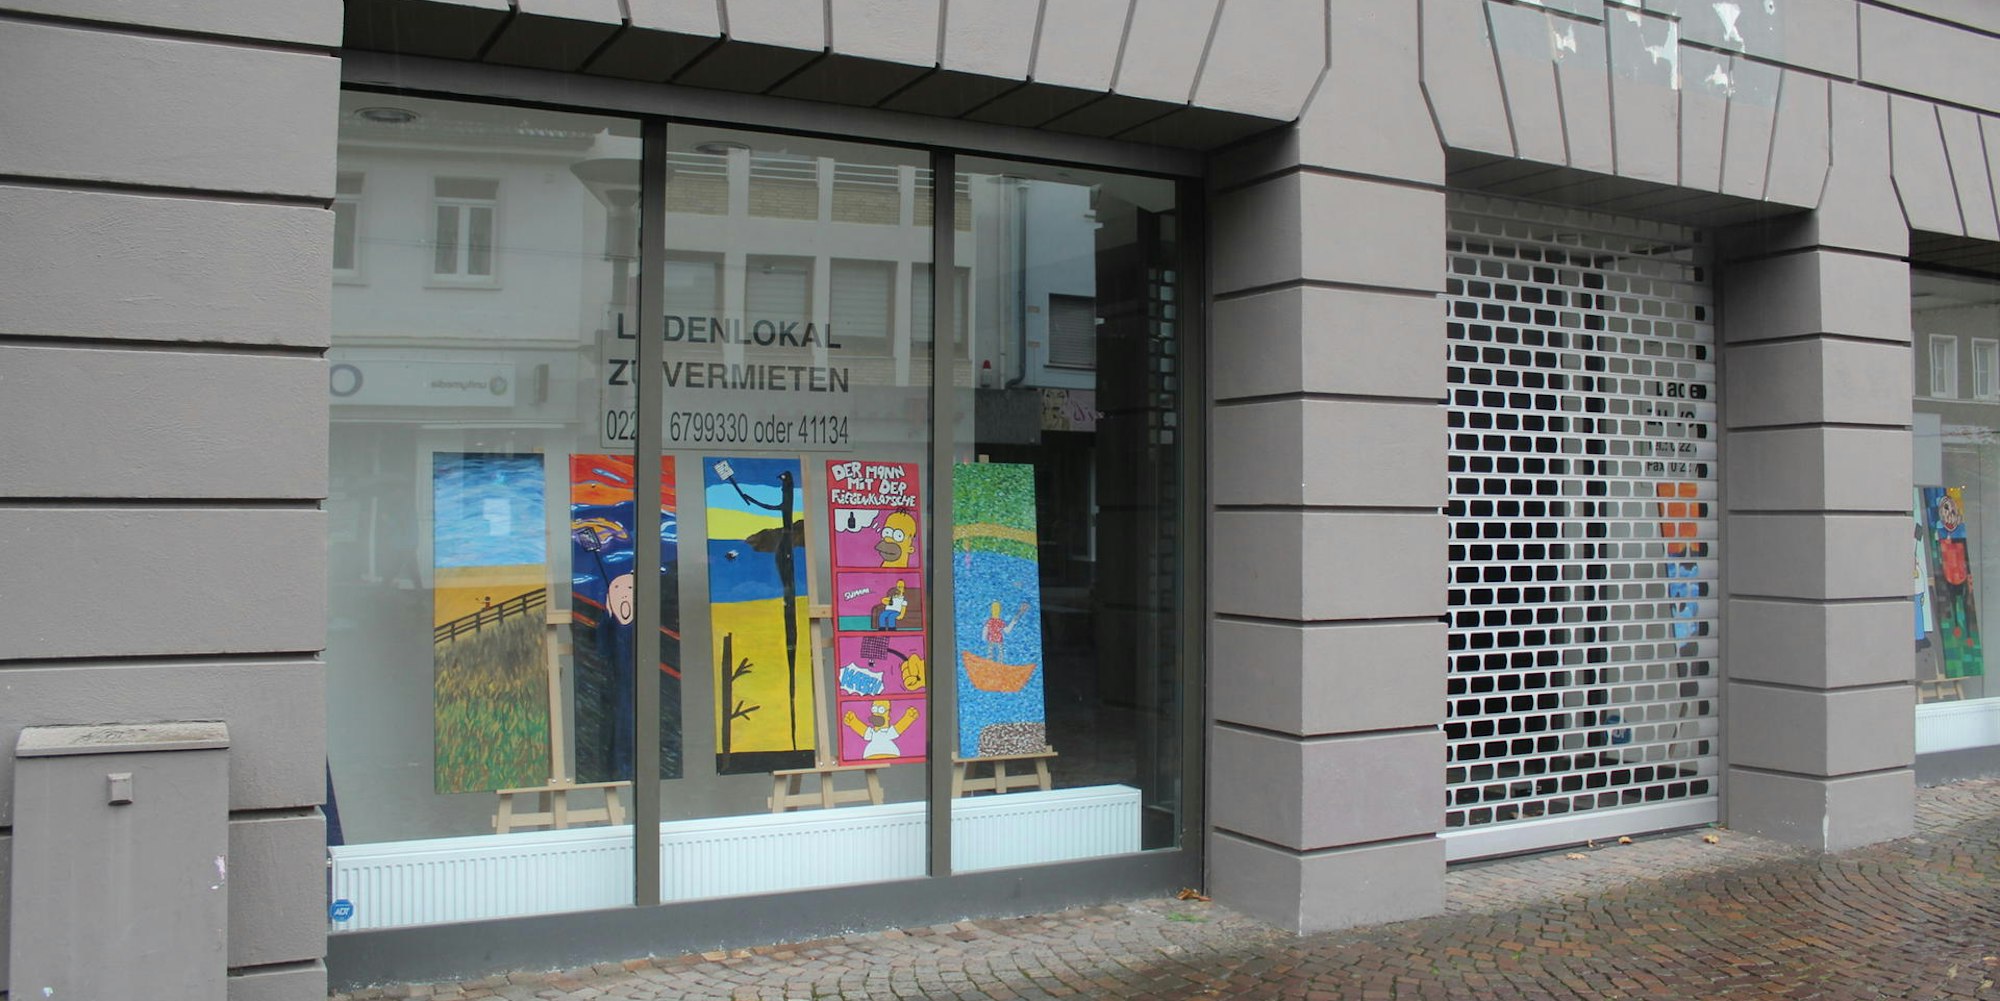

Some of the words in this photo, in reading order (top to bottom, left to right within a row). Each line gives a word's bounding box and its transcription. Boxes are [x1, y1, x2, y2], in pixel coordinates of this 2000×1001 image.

[617, 312, 842, 349] LDENLOKAL
[608, 358, 637, 386] Z
[662, 360, 849, 393] VERMIETEN
[606, 410, 637, 441] 022
[670, 411, 748, 443] 6799330
[754, 414, 794, 443] oder
[798, 415, 849, 445] 41134
[832, 462, 862, 481] DER
[865, 465, 905, 479] MANN
[879, 479, 907, 496] DER
